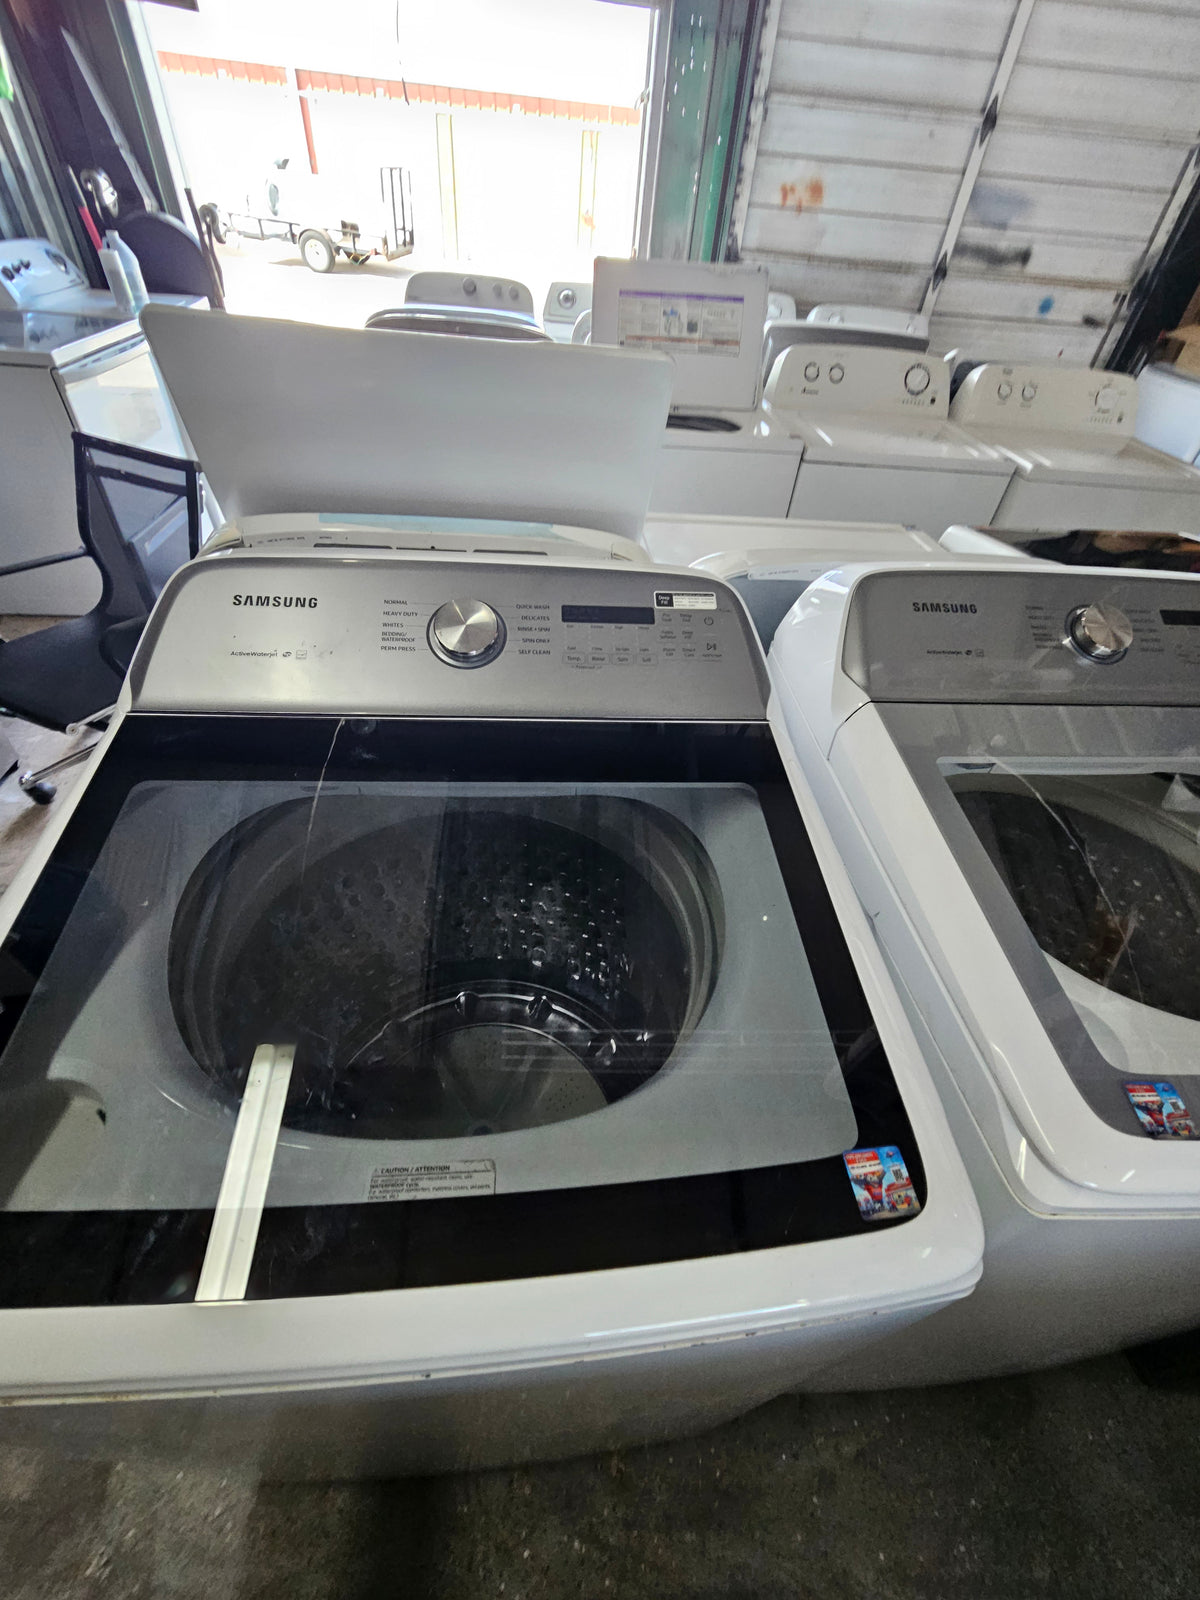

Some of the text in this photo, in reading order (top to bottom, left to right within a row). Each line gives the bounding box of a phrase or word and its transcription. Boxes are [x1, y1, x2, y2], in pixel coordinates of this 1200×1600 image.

[232, 594, 318, 608] SAMSUNG
[912, 602, 977, 614] SAMSUNG
[415, 1165, 450, 1173] ATTENTION
